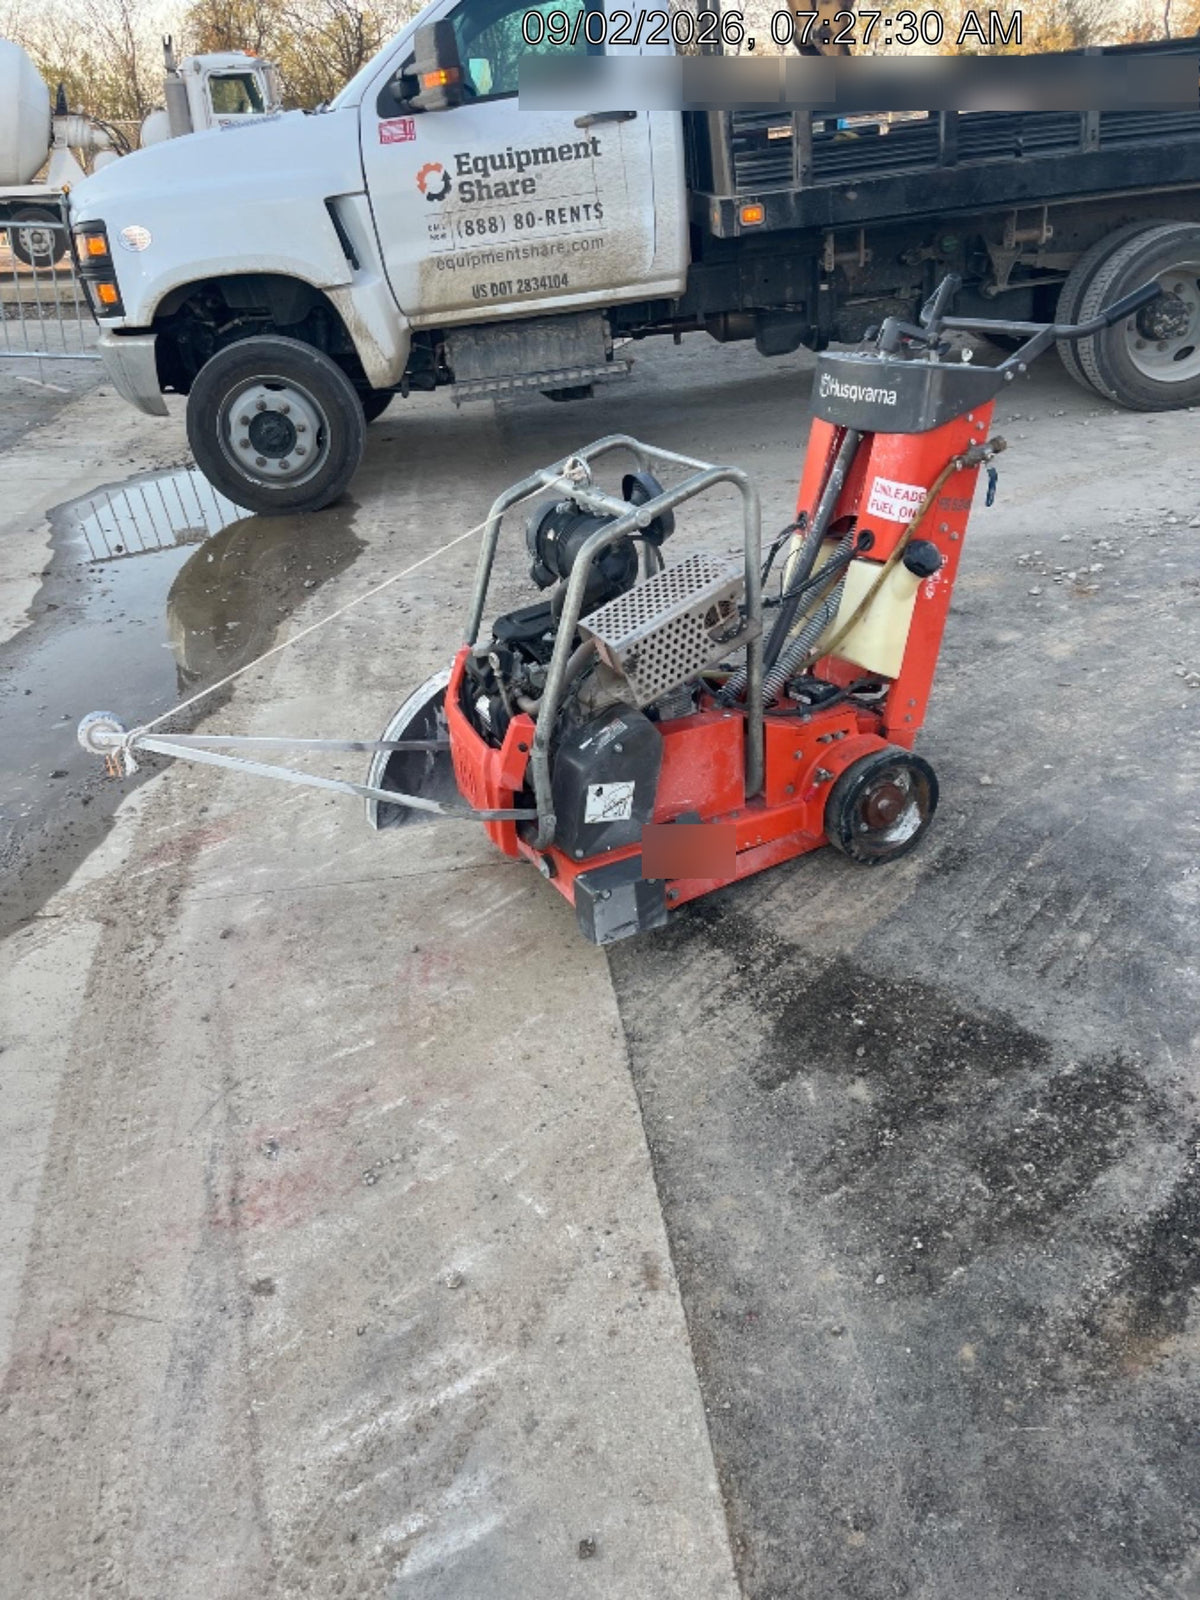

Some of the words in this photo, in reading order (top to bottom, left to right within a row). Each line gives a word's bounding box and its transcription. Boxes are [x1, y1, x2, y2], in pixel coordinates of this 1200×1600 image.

[453, 136, 602, 178] Equipment
[457, 213, 506, 239] (888)
[513, 201, 604, 231] 80-RENTS
[436, 236, 604, 272] equipmentshare.com
[472, 284, 488, 299] US
[490, 280, 513, 297] DOT
[516, 272, 569, 294] 2834104
[829, 377, 898, 406] Husqvarna
[874, 481, 926, 504] UNLEADE
[870, 498, 895, 517] FUEL
